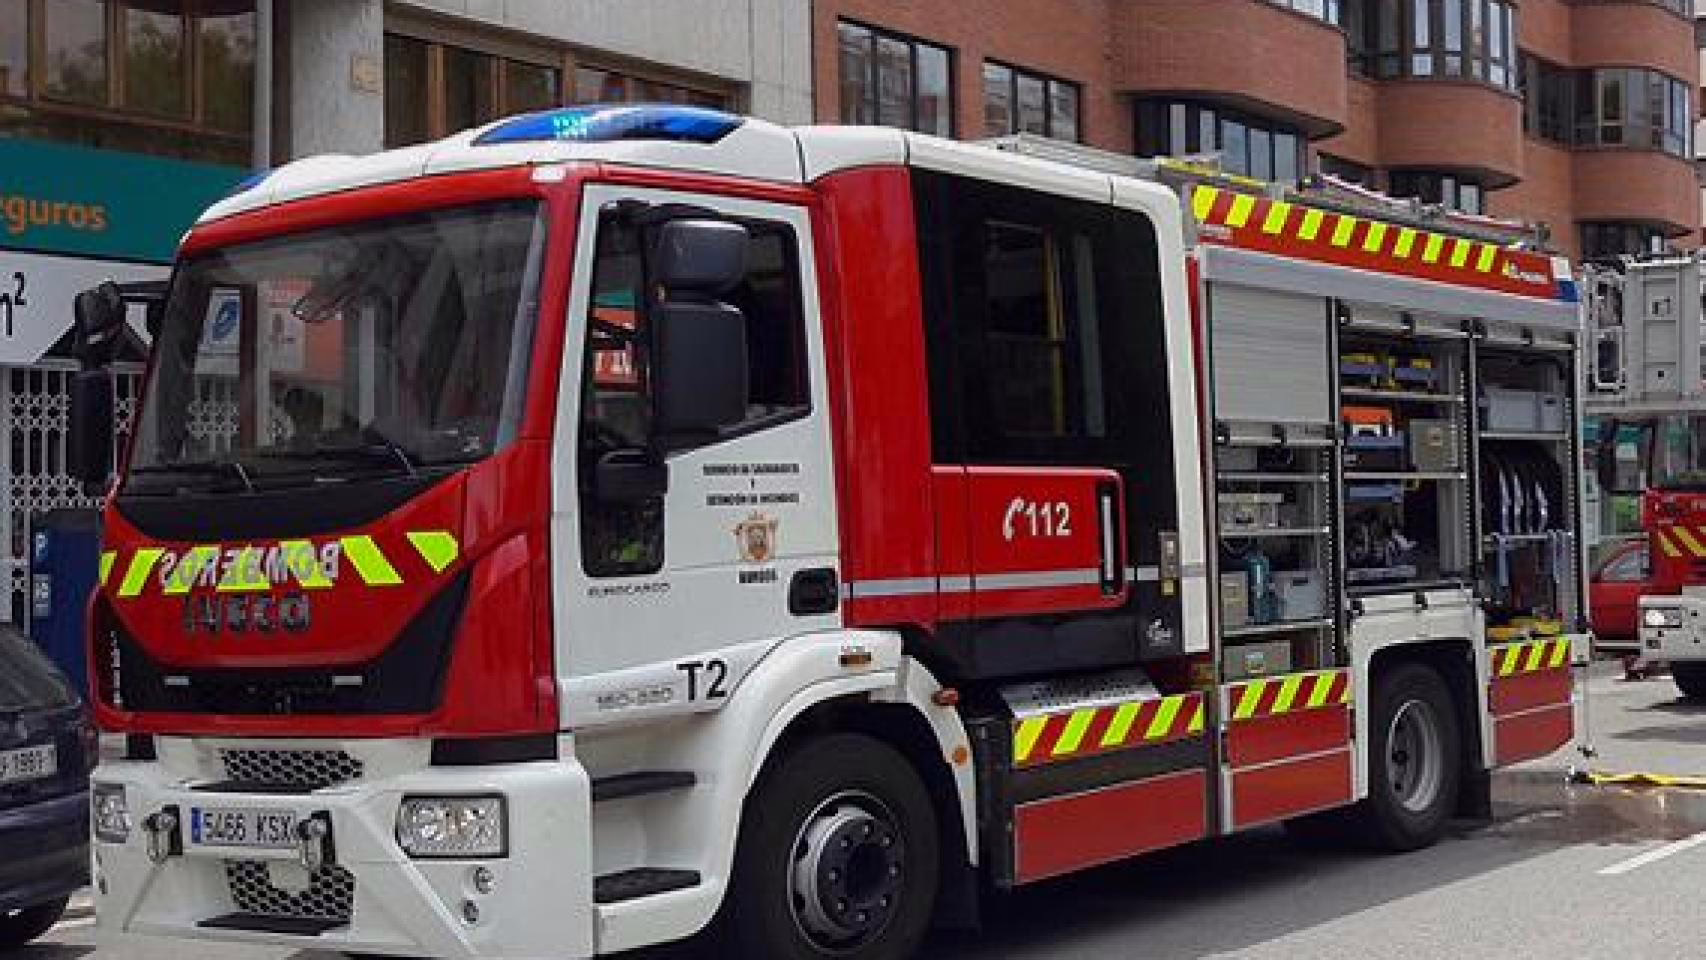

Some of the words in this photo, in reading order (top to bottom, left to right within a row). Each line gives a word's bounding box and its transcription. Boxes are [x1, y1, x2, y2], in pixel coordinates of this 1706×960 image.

[0, 197, 107, 235] guros
[1025, 501, 1072, 537] 112
[676, 658, 729, 704] T2
[203, 812, 246, 842] 5466
[256, 814, 292, 844] KSX
